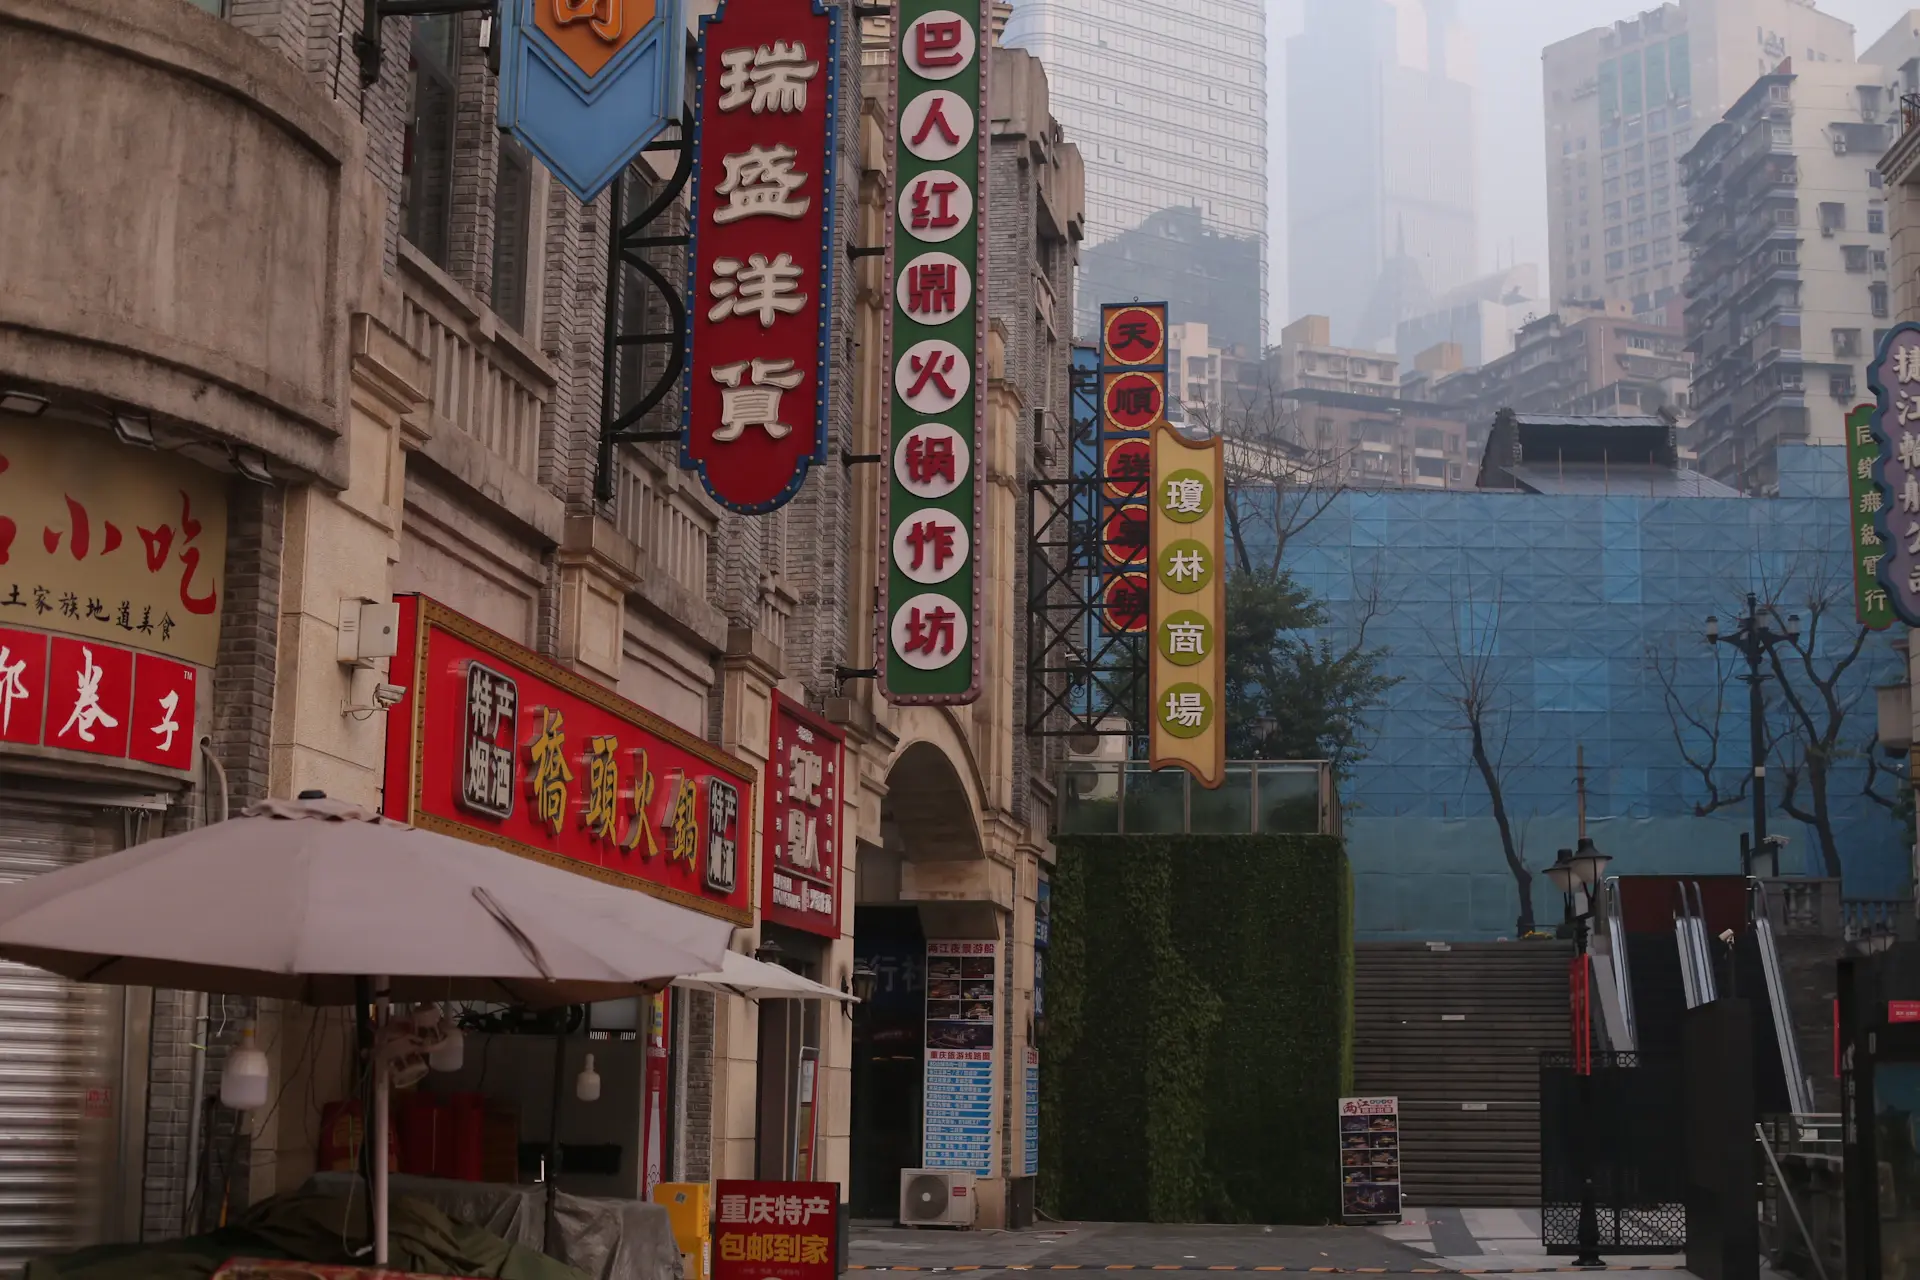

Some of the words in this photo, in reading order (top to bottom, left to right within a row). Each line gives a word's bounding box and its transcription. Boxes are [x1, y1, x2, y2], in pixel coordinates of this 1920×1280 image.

[708, 39, 819, 442] 瑞盛洋貨
[904, 19, 963, 655] 巴人红鼎火锅作坊
[0, 456, 217, 615] 小吃
[3, 584, 176, 642] 土家族地道美食
[1165, 477, 1206, 727] 瓊林商場
[184, 671, 193, 681] TM
[471, 669, 514, 739] 特产
[468, 738, 512, 810] 烟酒
[711, 784, 736, 833] 特产
[709, 835, 735, 886] 烟酒
[720, 1194, 830, 1226] 重庆特产
[719, 1232, 829, 1265] 包邮到家
